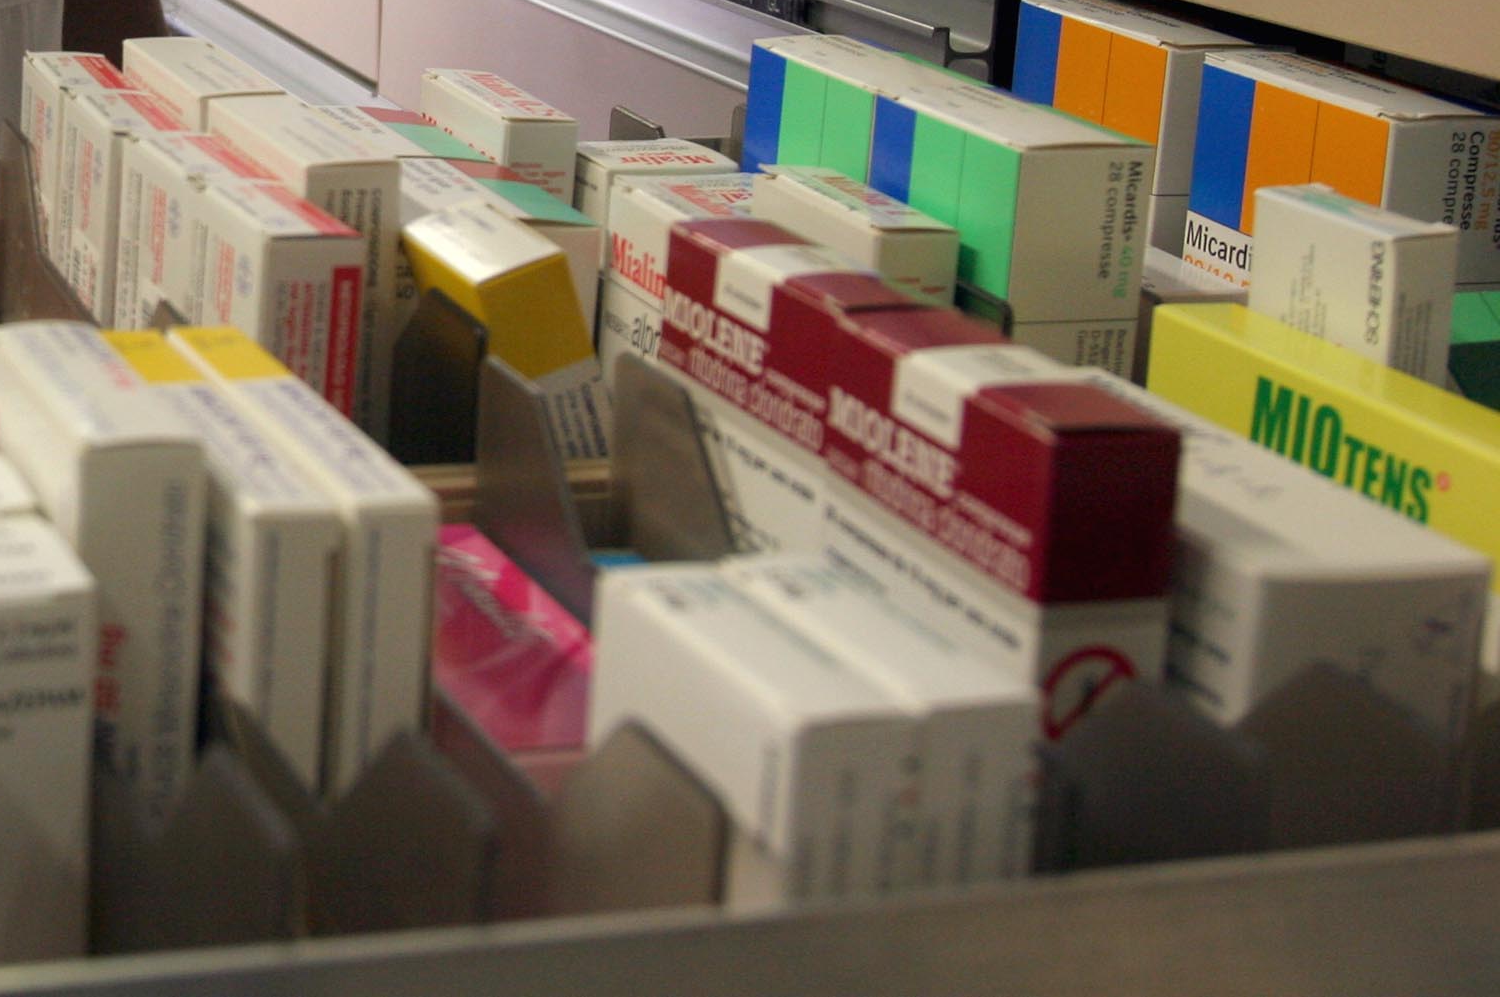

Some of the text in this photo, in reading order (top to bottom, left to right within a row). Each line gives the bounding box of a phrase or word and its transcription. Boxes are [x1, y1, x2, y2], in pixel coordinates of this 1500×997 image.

[1441, 131, 1467, 225] 28 compre
[1459, 130, 1485, 231] Compresse
[612, 232, 668, 300] Mialin
[1097, 187, 1120, 280] compresse
[1185, 219, 1253, 272] Micardi
[1251, 375, 1430, 525] MIOTENS
